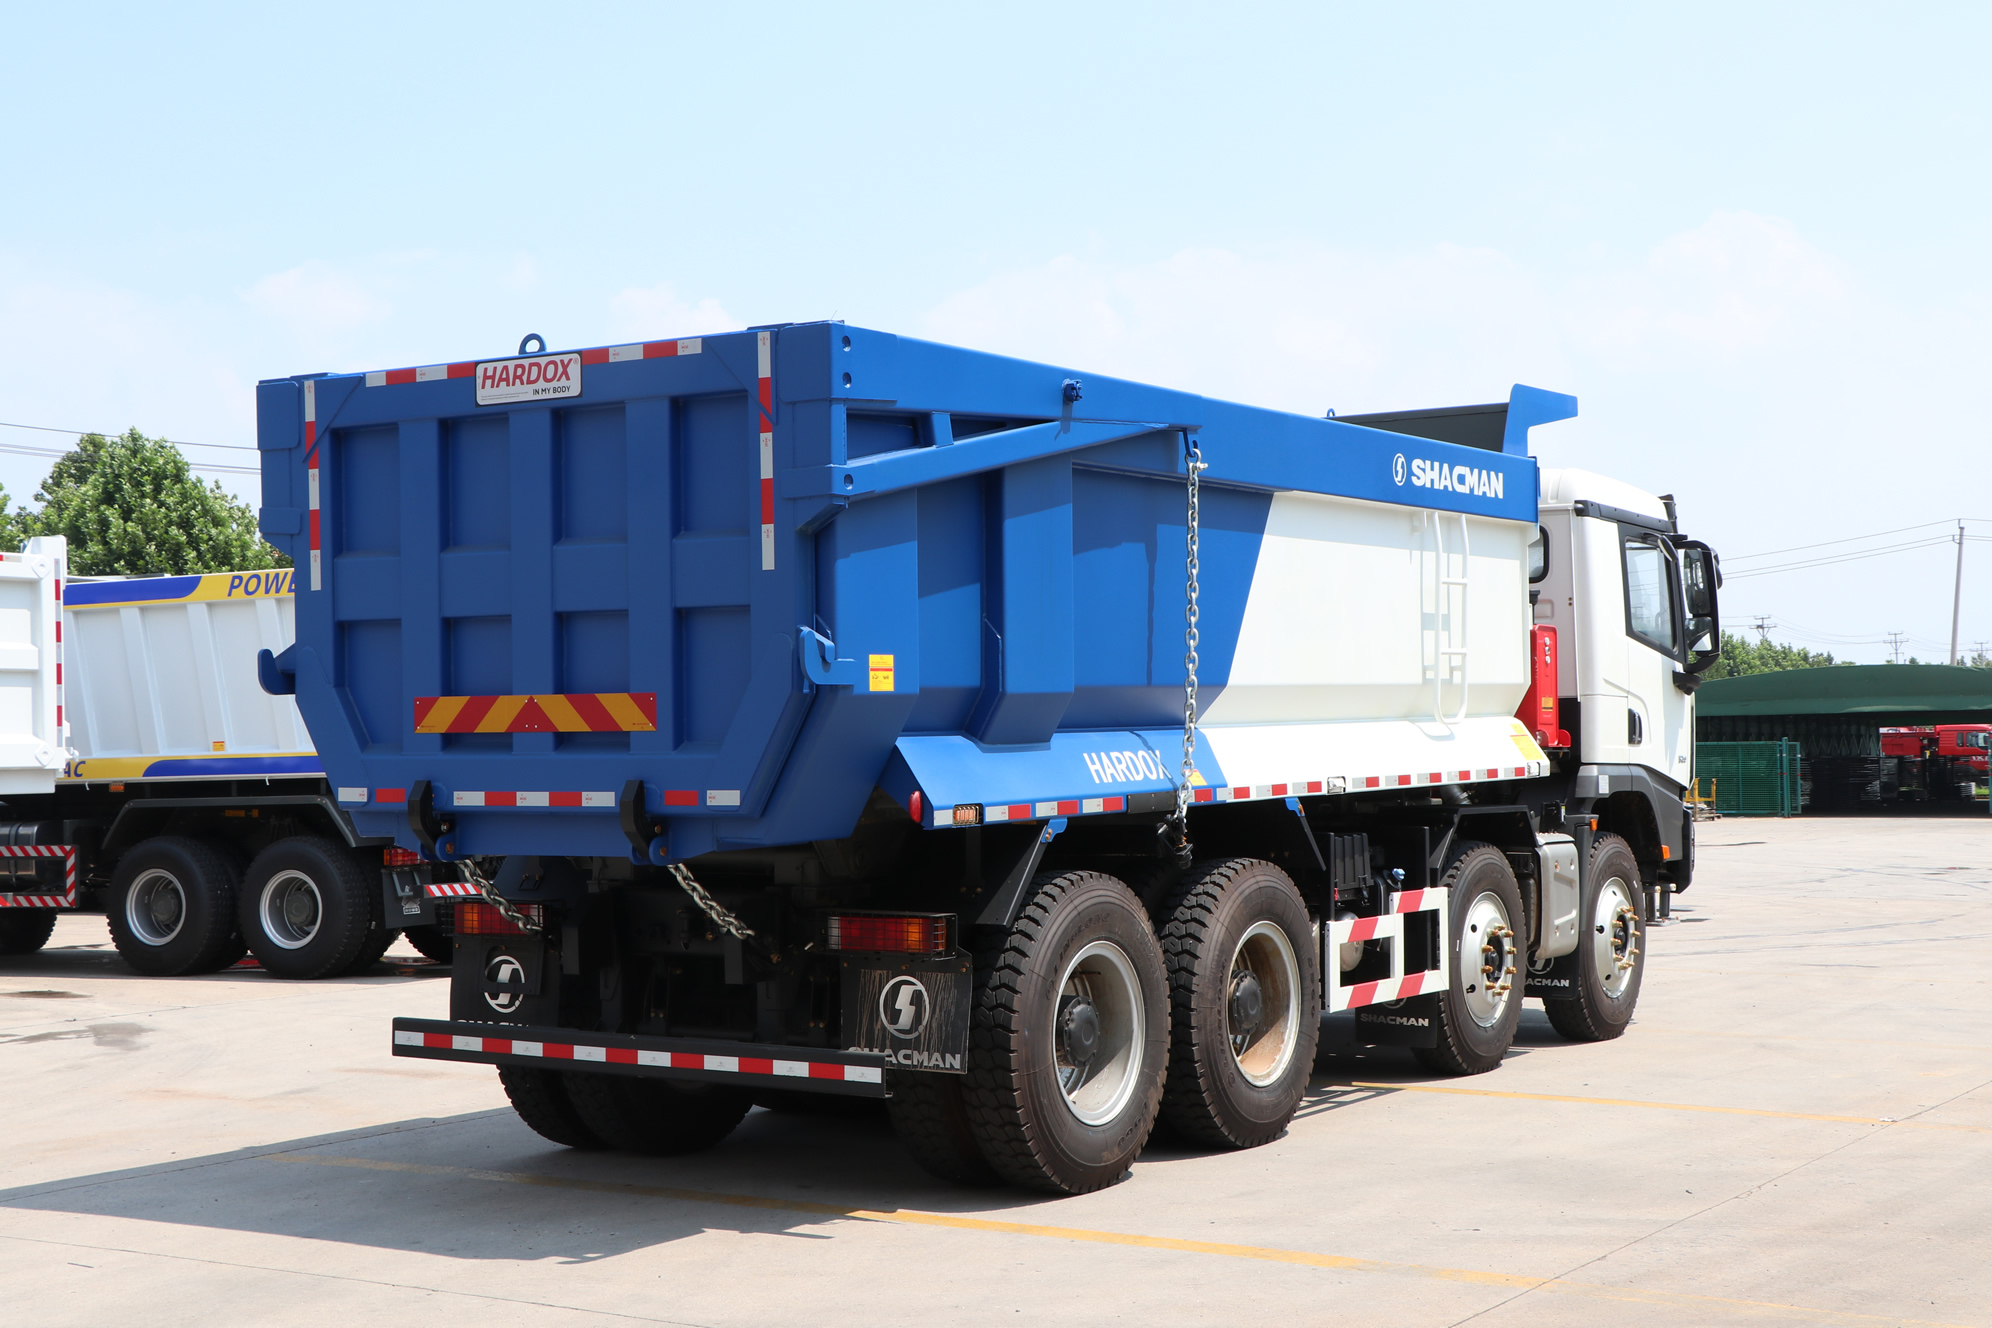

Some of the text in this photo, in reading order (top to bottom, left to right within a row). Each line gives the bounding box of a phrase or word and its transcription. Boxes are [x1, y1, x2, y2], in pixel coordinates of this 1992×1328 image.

[481, 358, 573, 389] HARDOX
[532, 385, 571, 396] IN MY BODY
[1411, 458, 1504, 499] SHACMAN
[1083, 749, 1172, 784] HARDOX
[1526, 977, 1570, 987] ACMAN
[1360, 1013, 1429, 1027] SHACMAN
[848, 1046, 961, 1069] ACMAN
